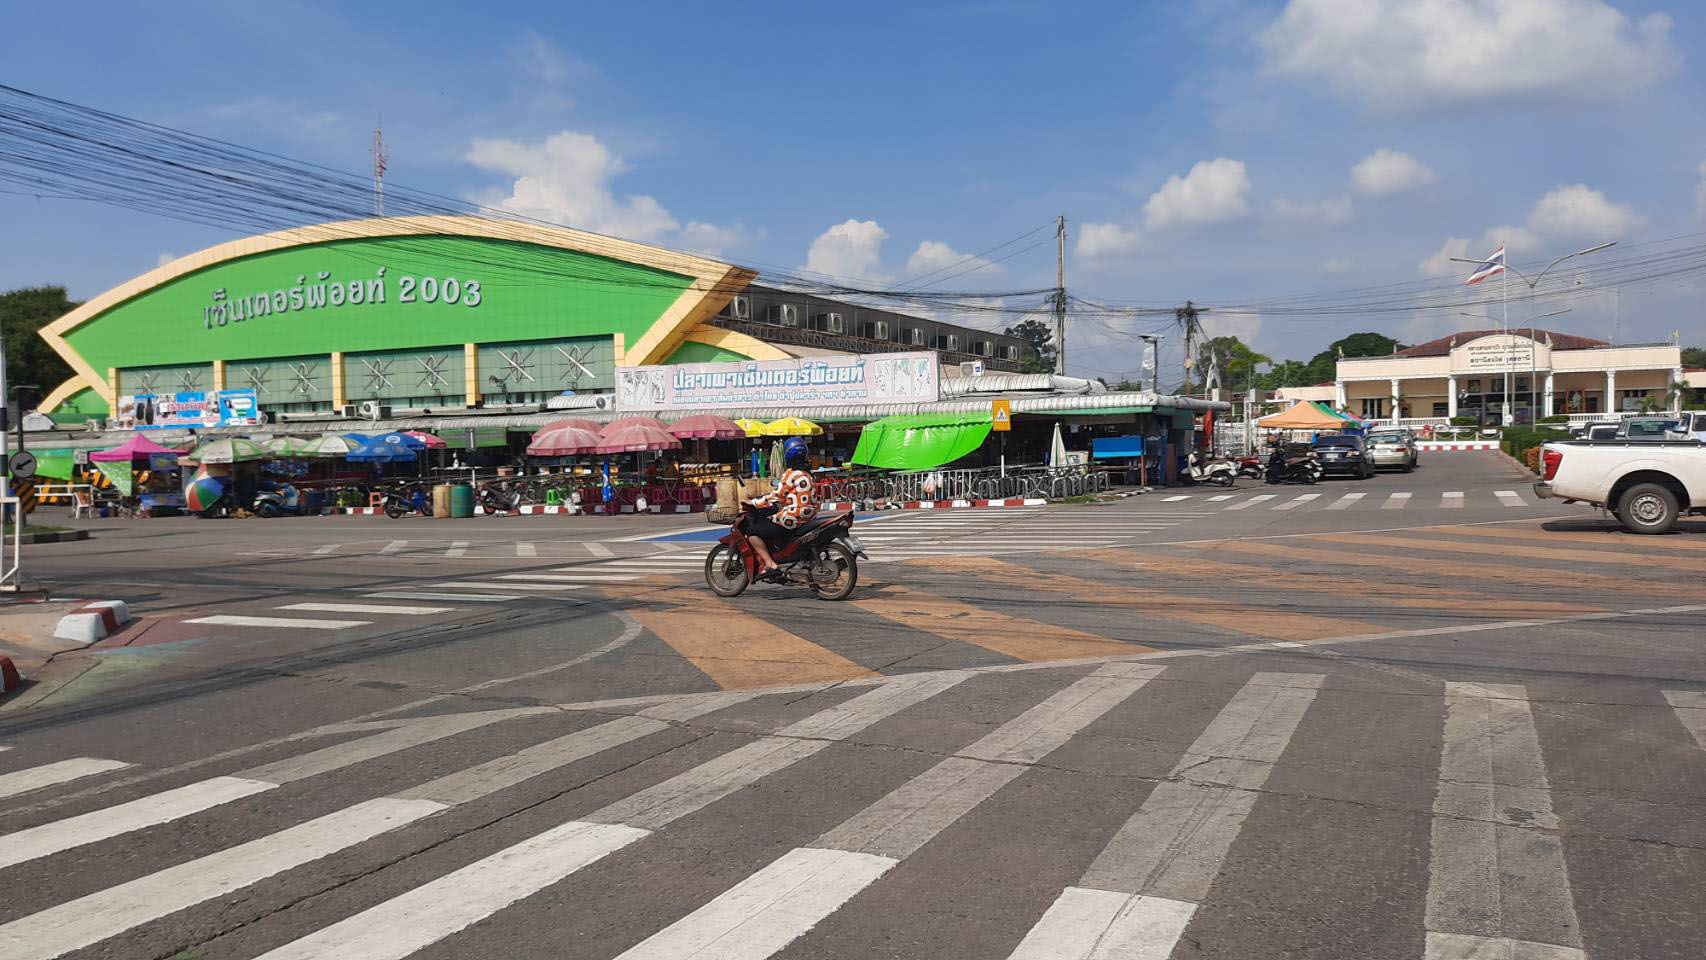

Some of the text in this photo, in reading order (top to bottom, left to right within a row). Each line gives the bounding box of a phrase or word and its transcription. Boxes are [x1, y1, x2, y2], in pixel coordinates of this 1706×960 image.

[202, 267, 482, 330] เซ็นเตอร์พ้อยท์ 2003
